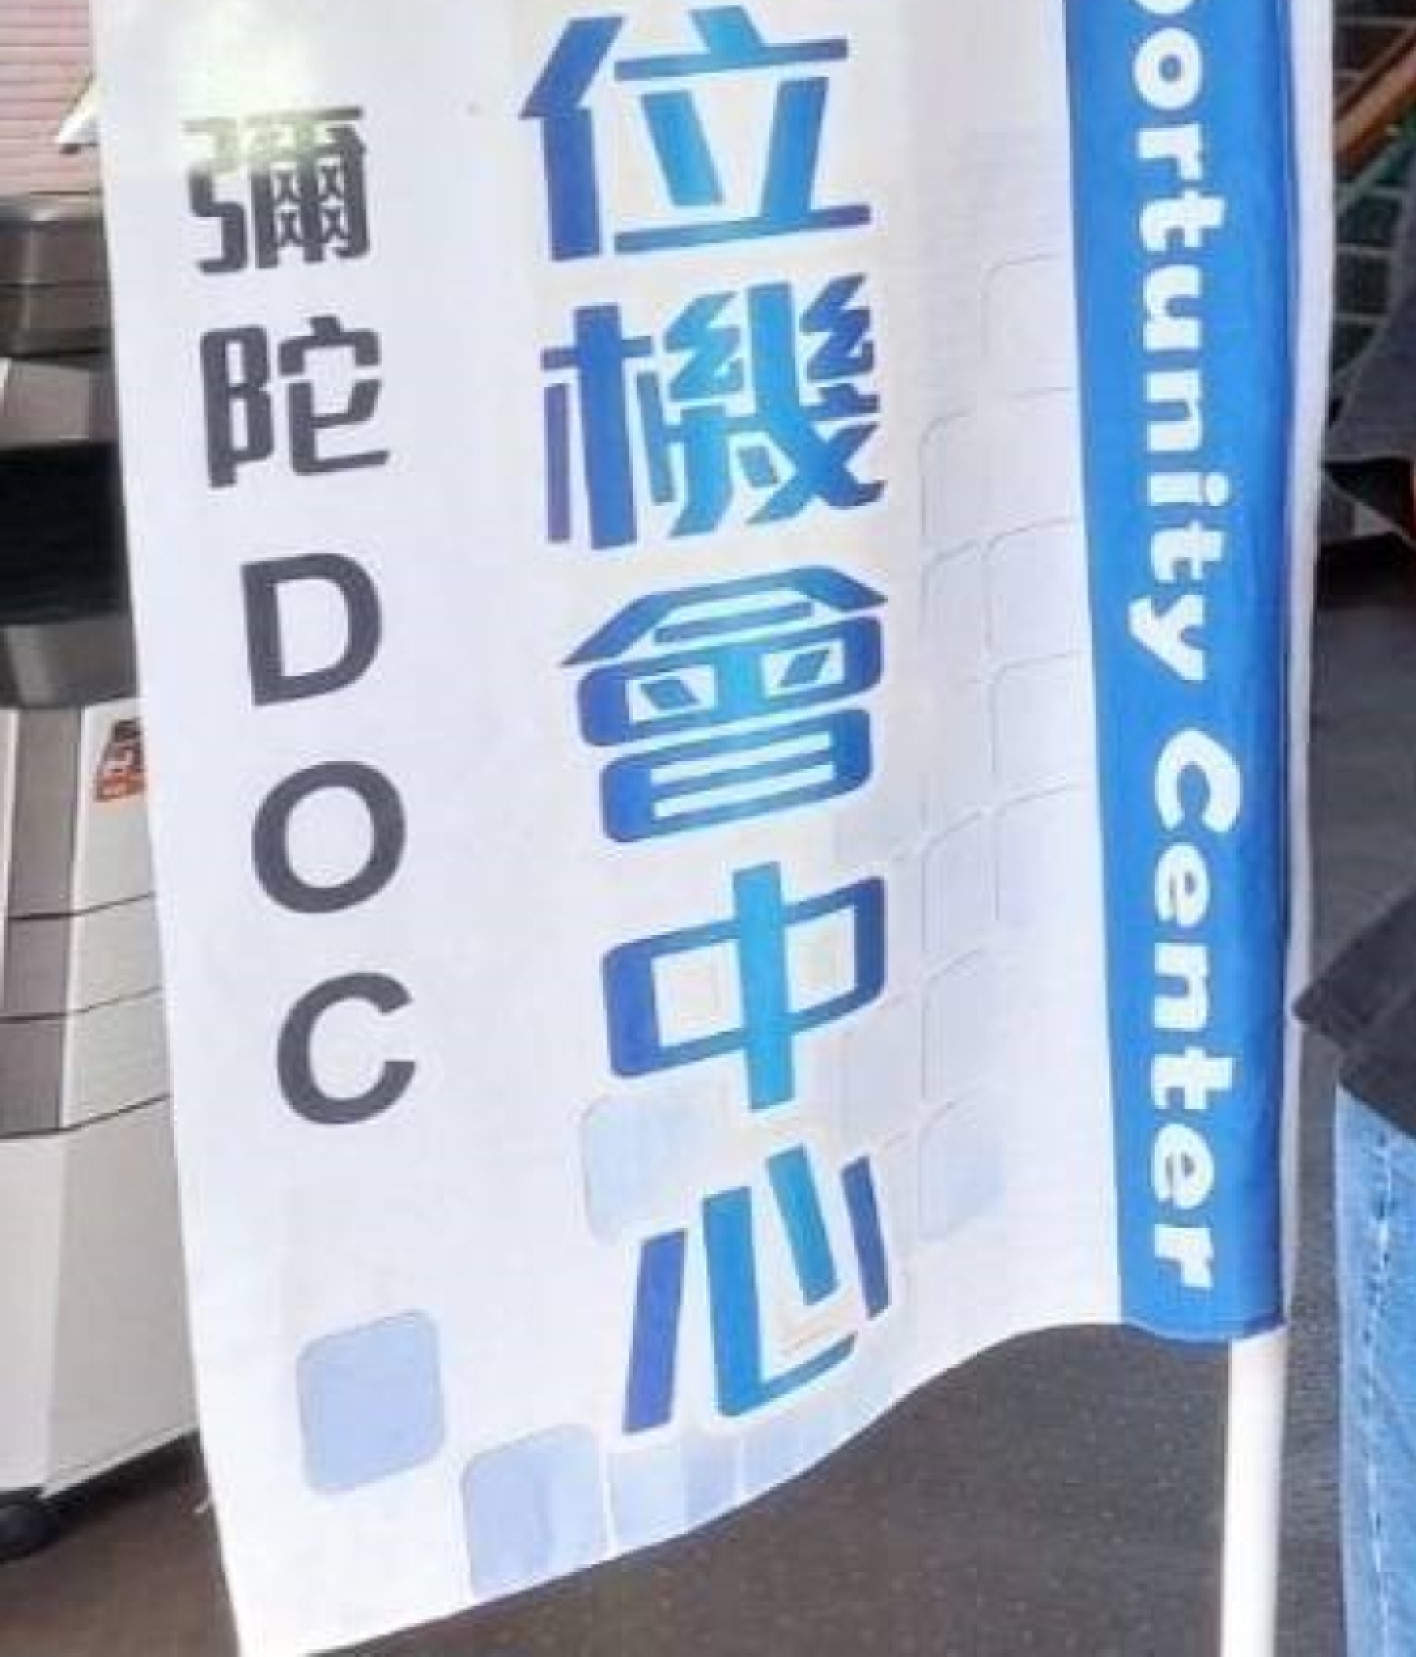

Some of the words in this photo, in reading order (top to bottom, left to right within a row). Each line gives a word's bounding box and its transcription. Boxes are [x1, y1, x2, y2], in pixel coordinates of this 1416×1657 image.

[182, 106, 390, 487] 彌陀
[242, 551, 417, 1128] DOC
[1150, 726, 1243, 1289] Center
